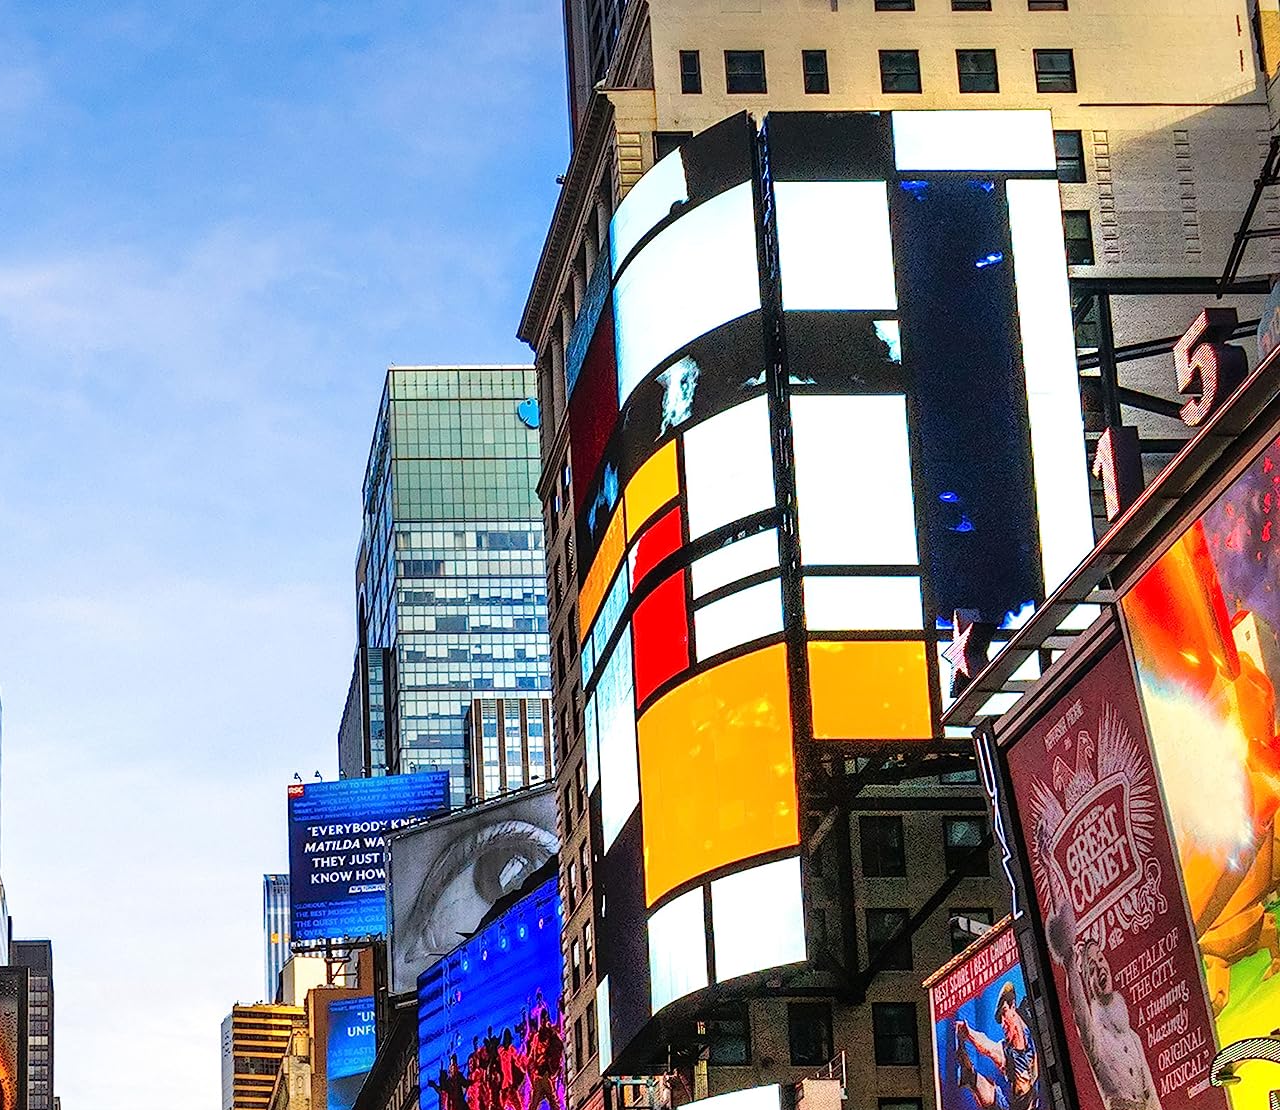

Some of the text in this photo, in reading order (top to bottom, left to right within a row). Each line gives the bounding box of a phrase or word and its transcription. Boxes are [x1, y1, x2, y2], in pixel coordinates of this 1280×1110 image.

[288, 787, 304, 796] RSC
[304, 839, 360, 854] MATILDA
[312, 852, 380, 868] THEY JUST
[1067, 805, 1120, 874] GREAT
[311, 869, 386, 884] KNOW HOW
[1070, 836, 1129, 912] COMET
[1139, 941, 1168, 976] TALK
[1166, 927, 1180, 946] OF
[934, 949, 992, 1006] BEST SCORE BEST
[938, 995, 956, 1014] 2012
[958, 981, 978, 1004] TONY
[978, 959, 1005, 988] AWARD
[1129, 980, 1151, 1005] THE
[1147, 1008, 1190, 1050] blazingly
[1158, 1026, 1207, 1072] ORIGINAL
